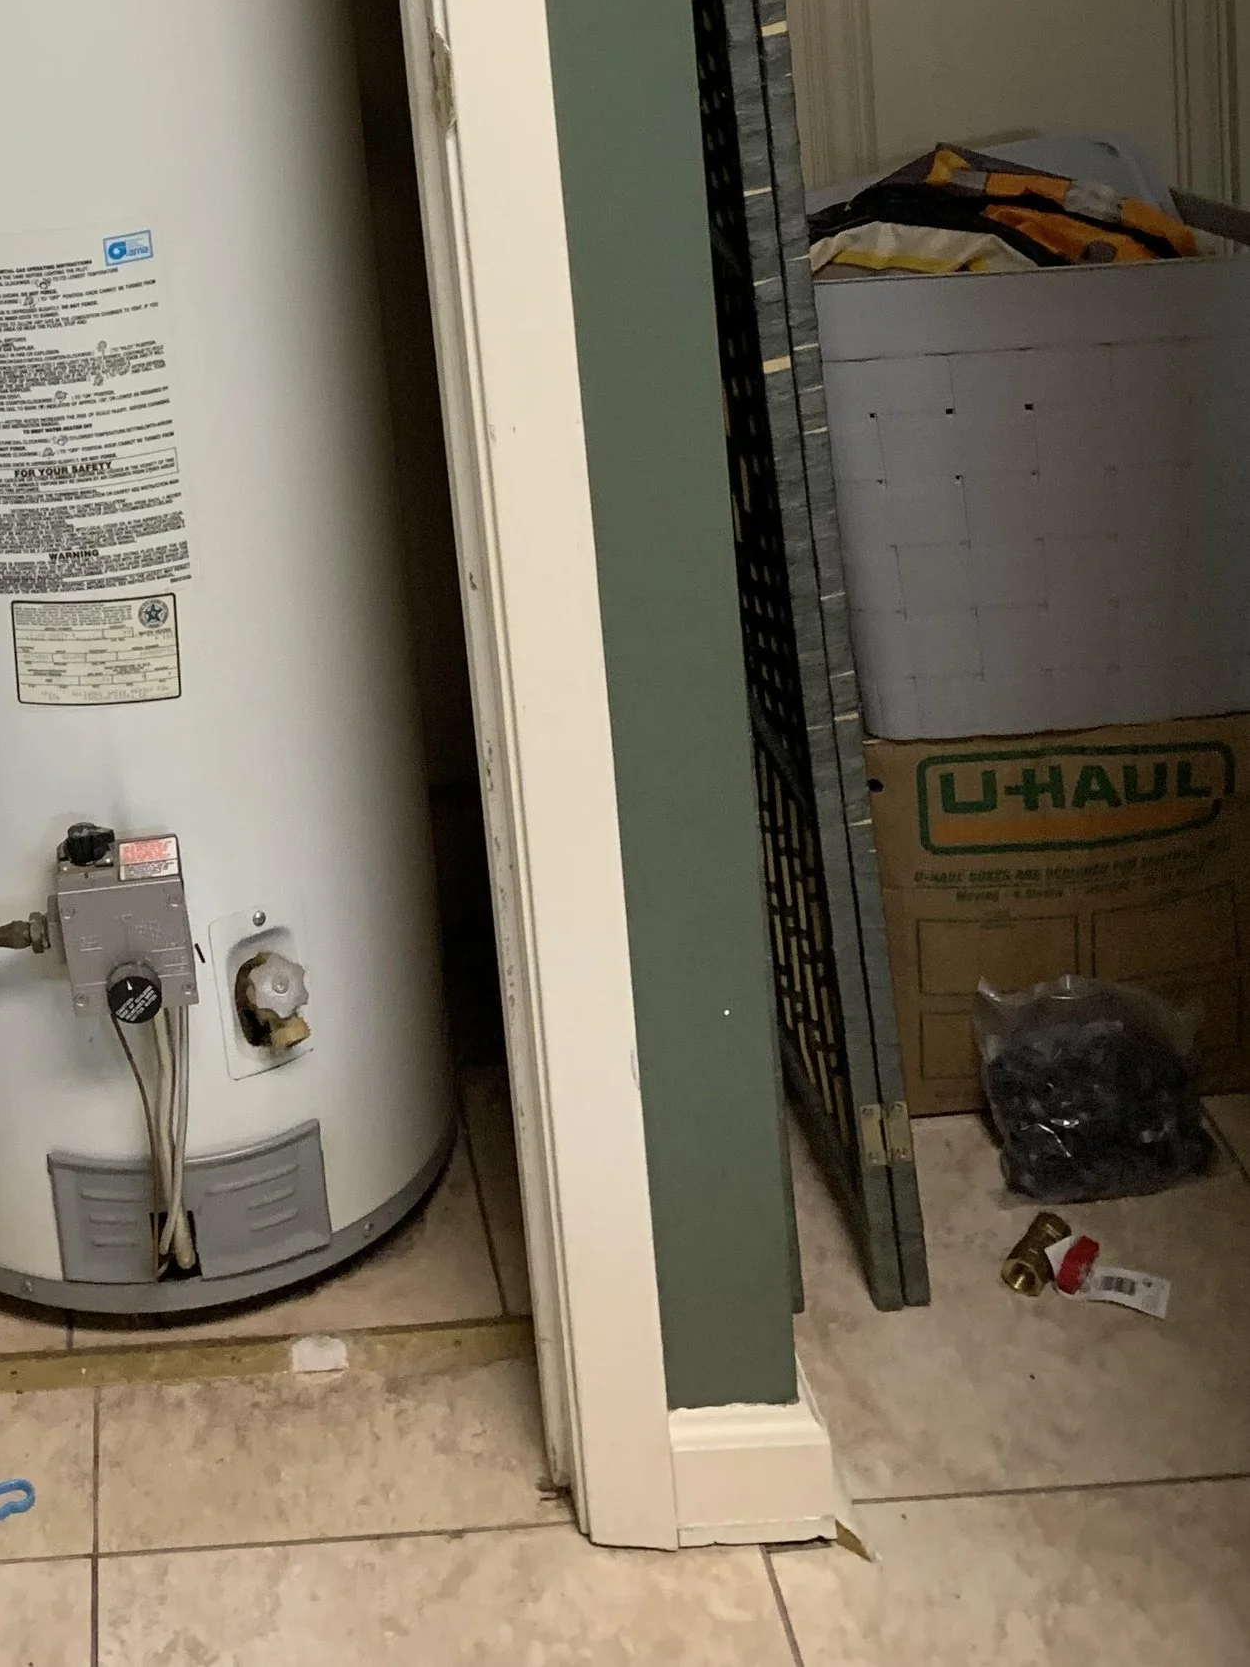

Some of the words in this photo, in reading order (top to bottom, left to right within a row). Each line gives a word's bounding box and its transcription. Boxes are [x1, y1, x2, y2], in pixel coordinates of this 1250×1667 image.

[14, 469, 36, 477] FOR
[38, 466, 68, 476] YOUR
[71, 462, 111, 473] SAFETY
[48, 549, 99, 561] WARNING
[939, 761, 1211, 814] U-HAUL
